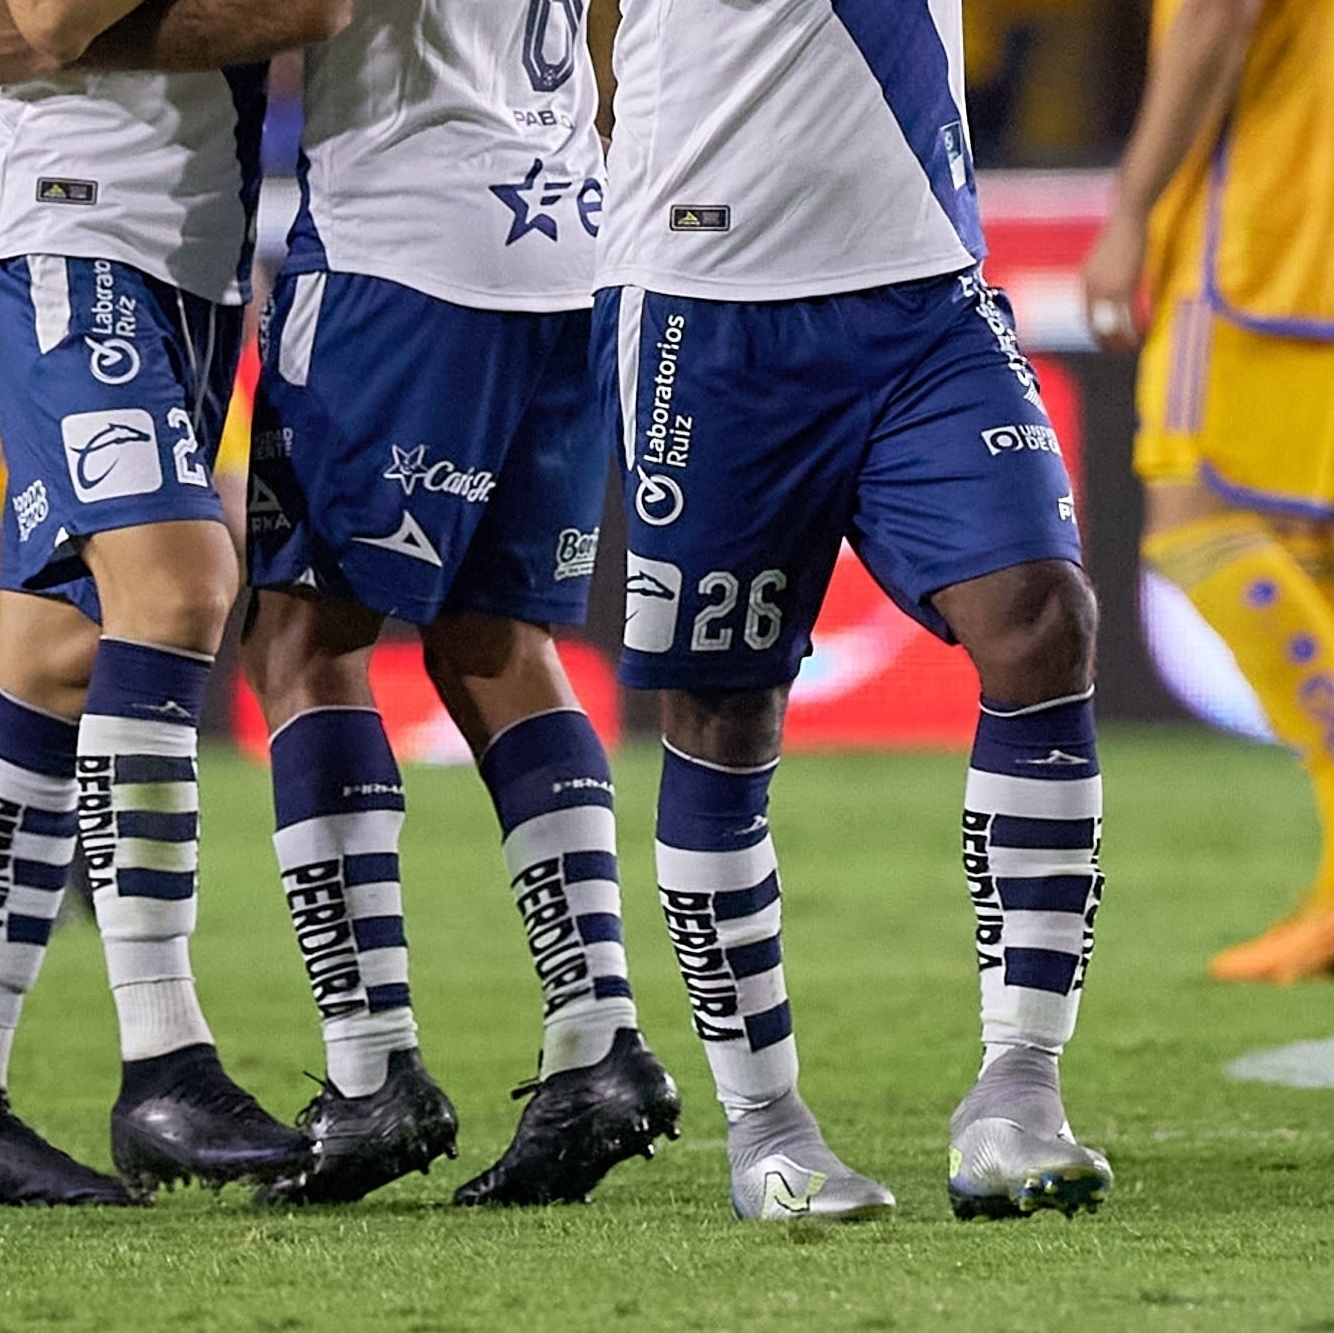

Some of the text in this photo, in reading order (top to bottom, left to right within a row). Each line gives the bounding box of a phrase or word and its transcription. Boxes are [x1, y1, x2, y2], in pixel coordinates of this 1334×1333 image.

[512, 109, 576, 129] PABO
[643, 314, 686, 466] Laboratorios
[667, 415, 693, 467] Ruiz
[690, 569, 788, 652] 26
[281, 858, 367, 1019] PERDURA
[511, 856, 594, 1018] PERDURA
[657, 883, 745, 1042] PERDURA
